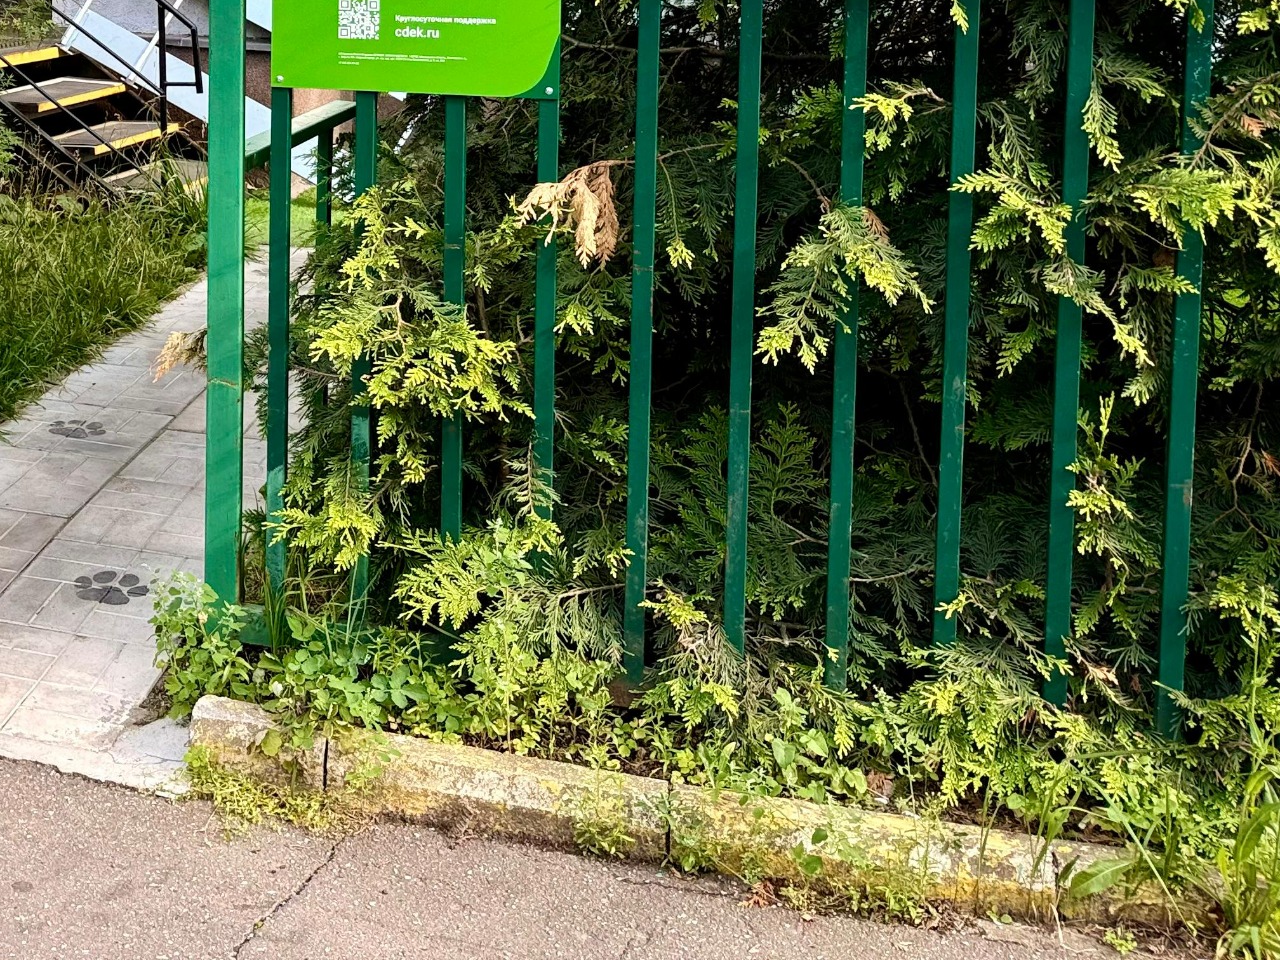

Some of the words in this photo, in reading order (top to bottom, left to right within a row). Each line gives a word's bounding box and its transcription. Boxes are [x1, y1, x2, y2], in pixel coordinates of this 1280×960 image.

[395, 14, 453, 24] Круглосуточная
[453, 16, 497, 25] поддержка
[394, 26, 440, 39] cdek.ru
